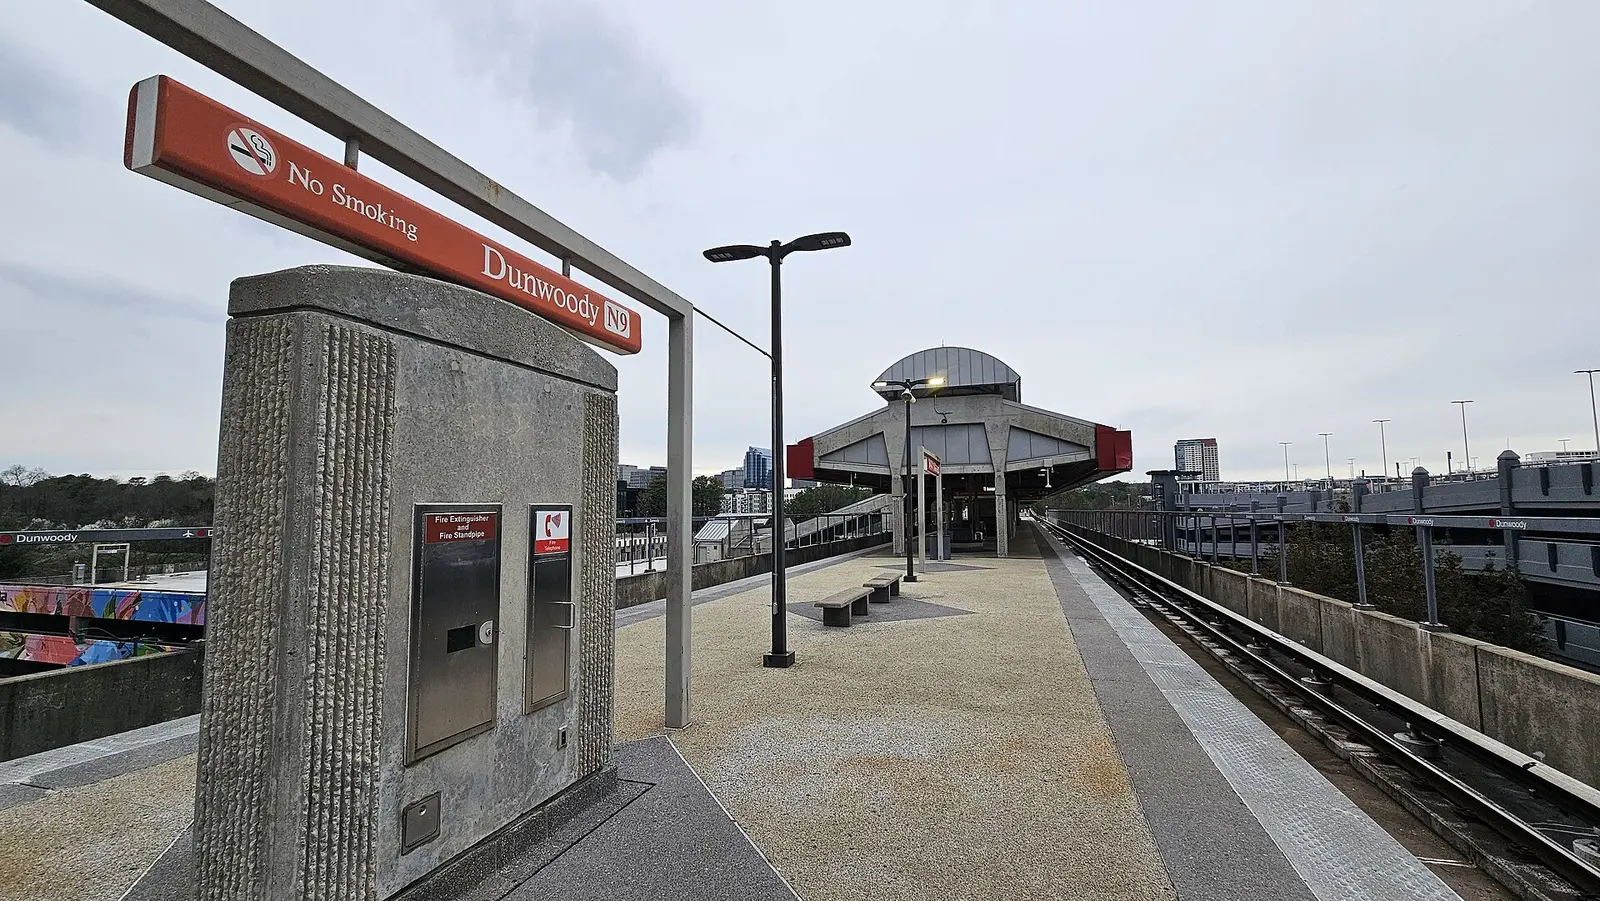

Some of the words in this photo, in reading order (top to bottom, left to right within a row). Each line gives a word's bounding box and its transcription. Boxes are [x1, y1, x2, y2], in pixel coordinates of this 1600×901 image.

[287, 160, 324, 196] No
[332, 183, 419, 242] Smoking
[480, 243, 601, 326] Dunwoody
[606, 303, 628, 333] N9
[435, 515, 448, 524] Fire
[449, 514, 489, 524] Extinguisher
[1412, 517, 1434, 527] Dunwoody
[1495, 519, 1527, 530] Dunwoody
[16, 533, 78, 543] Dunwoody
[439, 532, 453, 540] Fire
[454, 531, 485, 539] Standpipe
